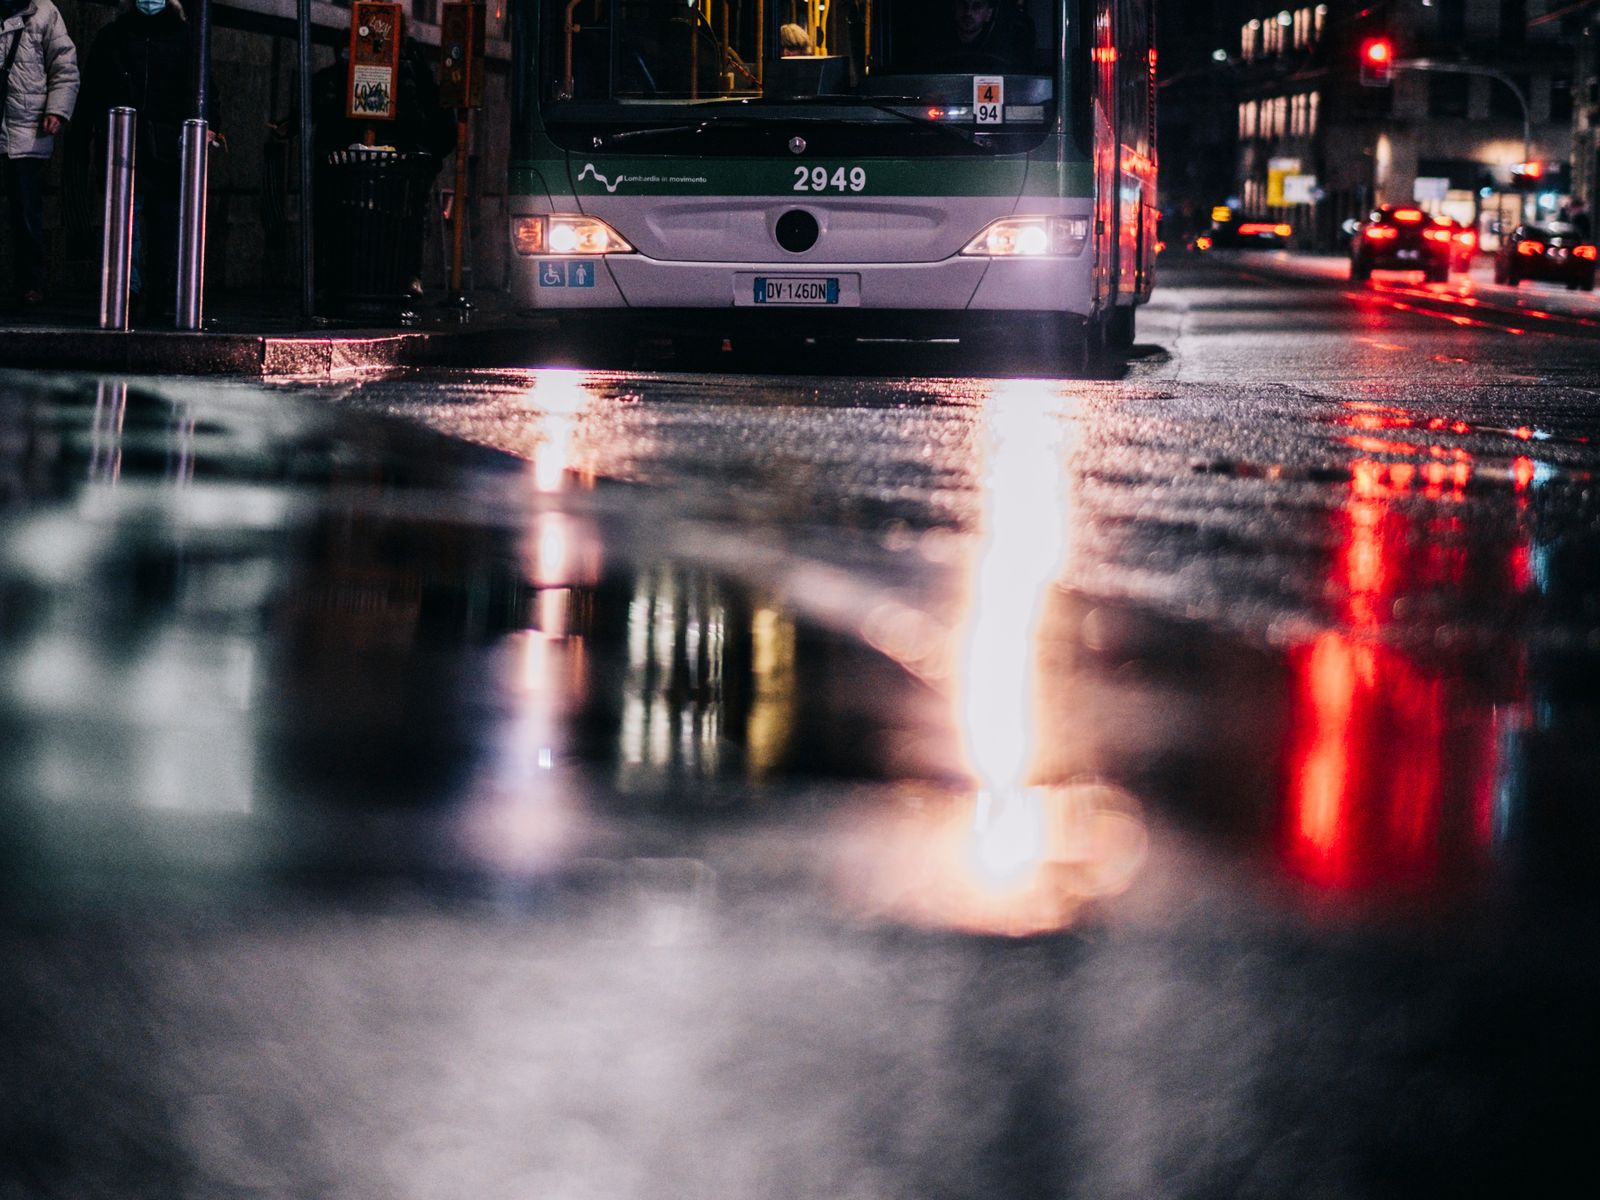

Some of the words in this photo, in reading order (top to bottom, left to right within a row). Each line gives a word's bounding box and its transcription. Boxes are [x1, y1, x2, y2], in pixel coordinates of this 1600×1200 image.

[983, 86, 994, 102] 4
[979, 105, 998, 121] 94
[793, 166, 866, 192] 2949
